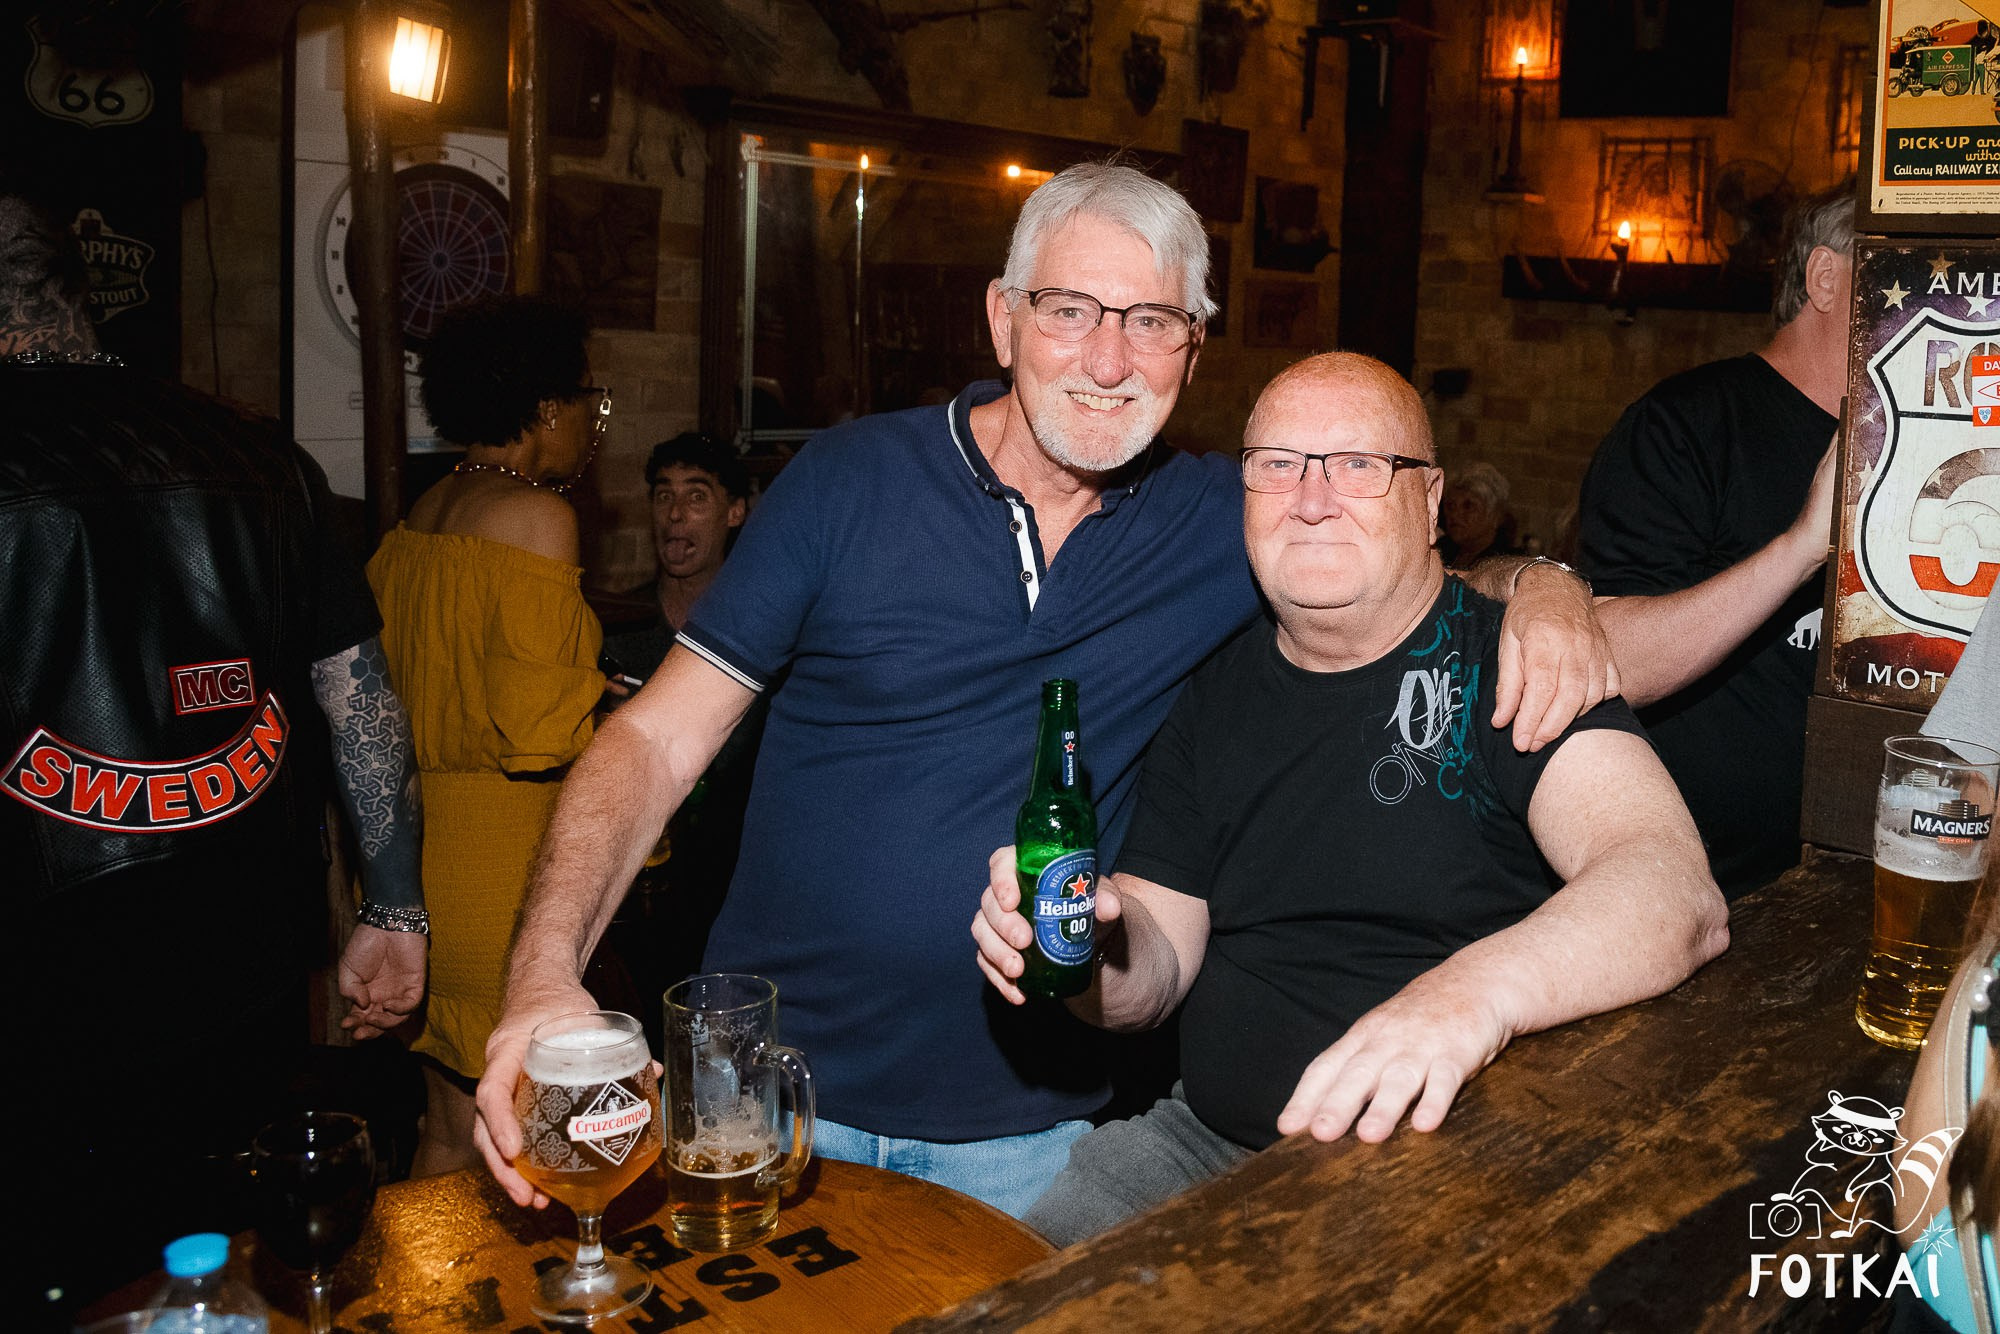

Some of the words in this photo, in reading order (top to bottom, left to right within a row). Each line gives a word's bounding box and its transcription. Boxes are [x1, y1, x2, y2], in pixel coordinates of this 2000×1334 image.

[59, 73, 125, 115] 66
[1893, 164, 1912, 175] Call
[1912, 167, 1932, 177] any
[1935, 164, 1983, 175] RAILWAY
[1985, 164, 2000, 175] EX
[89, 288, 138, 304] STOUT
[177, 666, 249, 708] MC
[19, 705, 282, 822] SWEDEN
[1913, 814, 1991, 835] MAGNERS
[575, 1107, 648, 1134] Cruzcampo
